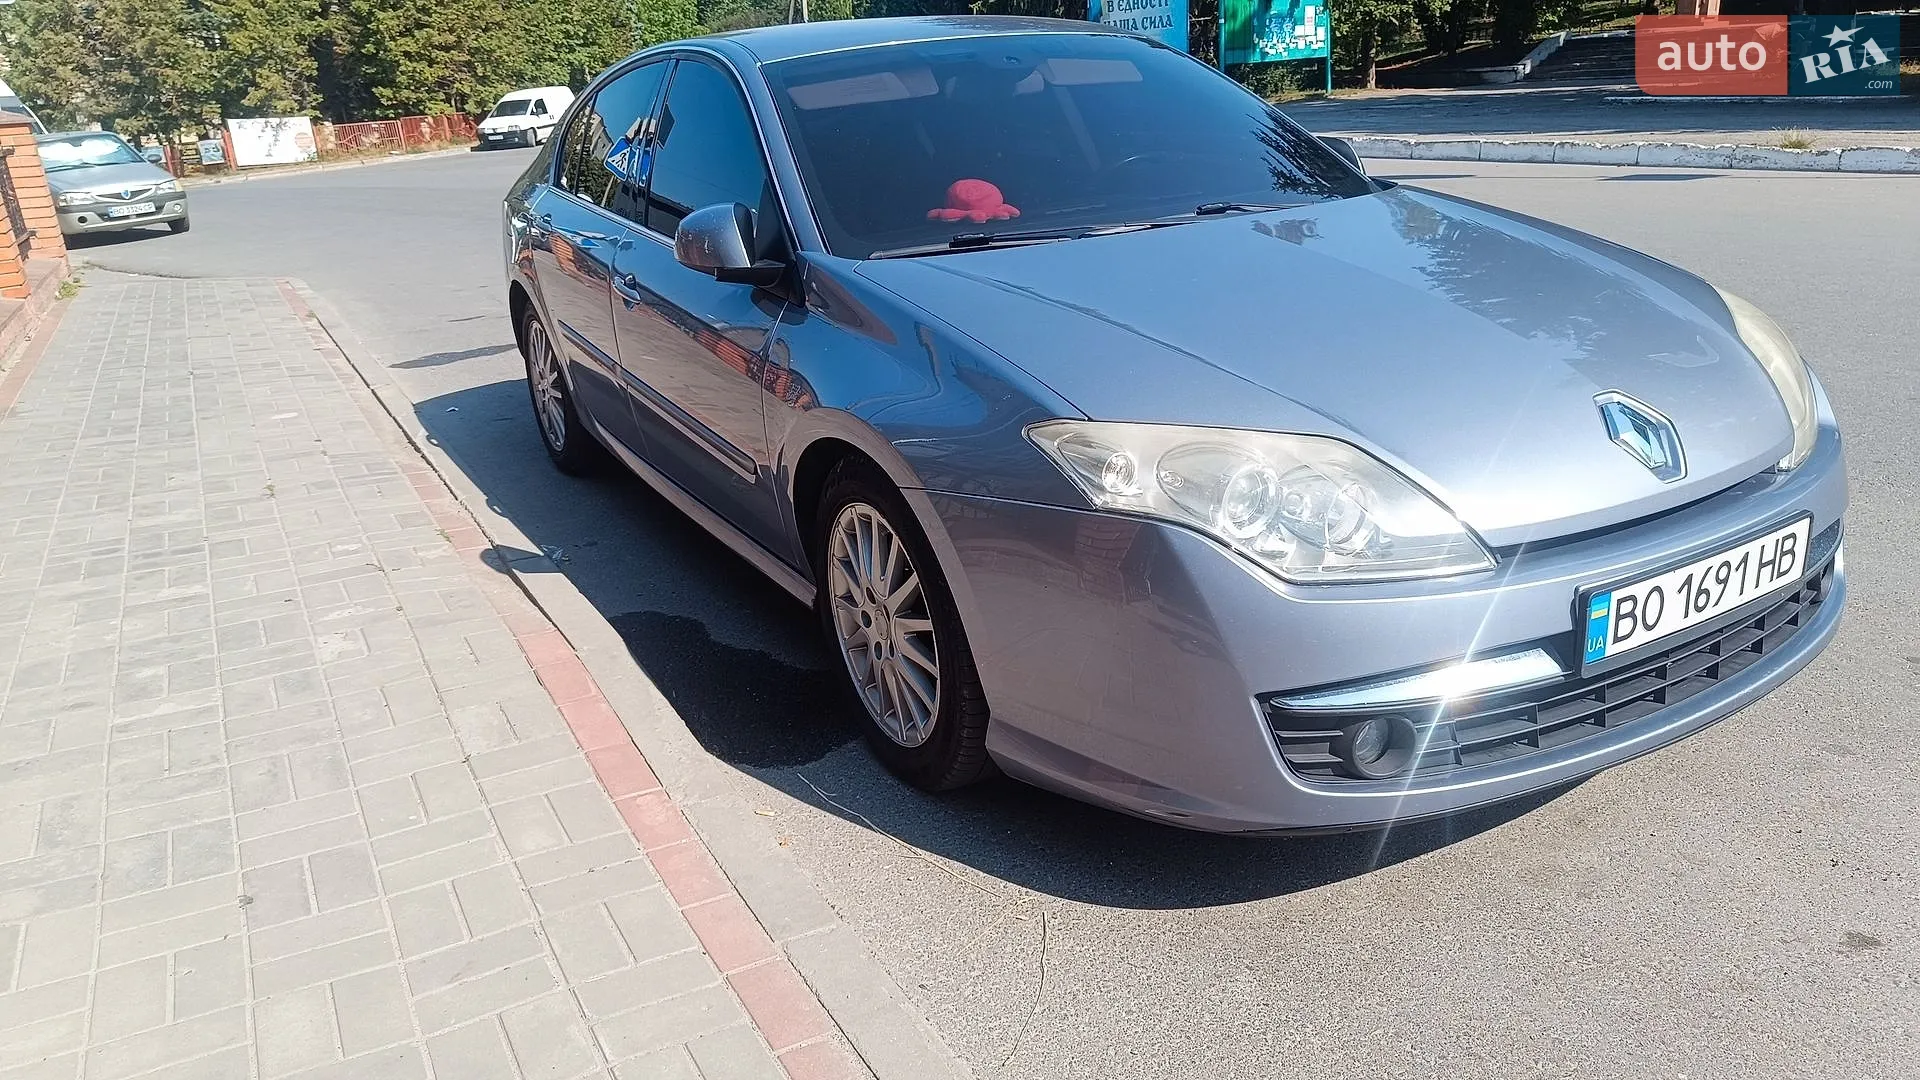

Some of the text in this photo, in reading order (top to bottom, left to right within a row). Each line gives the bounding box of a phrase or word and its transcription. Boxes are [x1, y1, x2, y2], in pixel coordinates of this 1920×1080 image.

[1106, 0, 1115, 13] В
[1141, 15, 1174, 31] СИЛА
[1611, 532, 1798, 645] BO 1691 HB
[1587, 636, 1605, 653] UA
